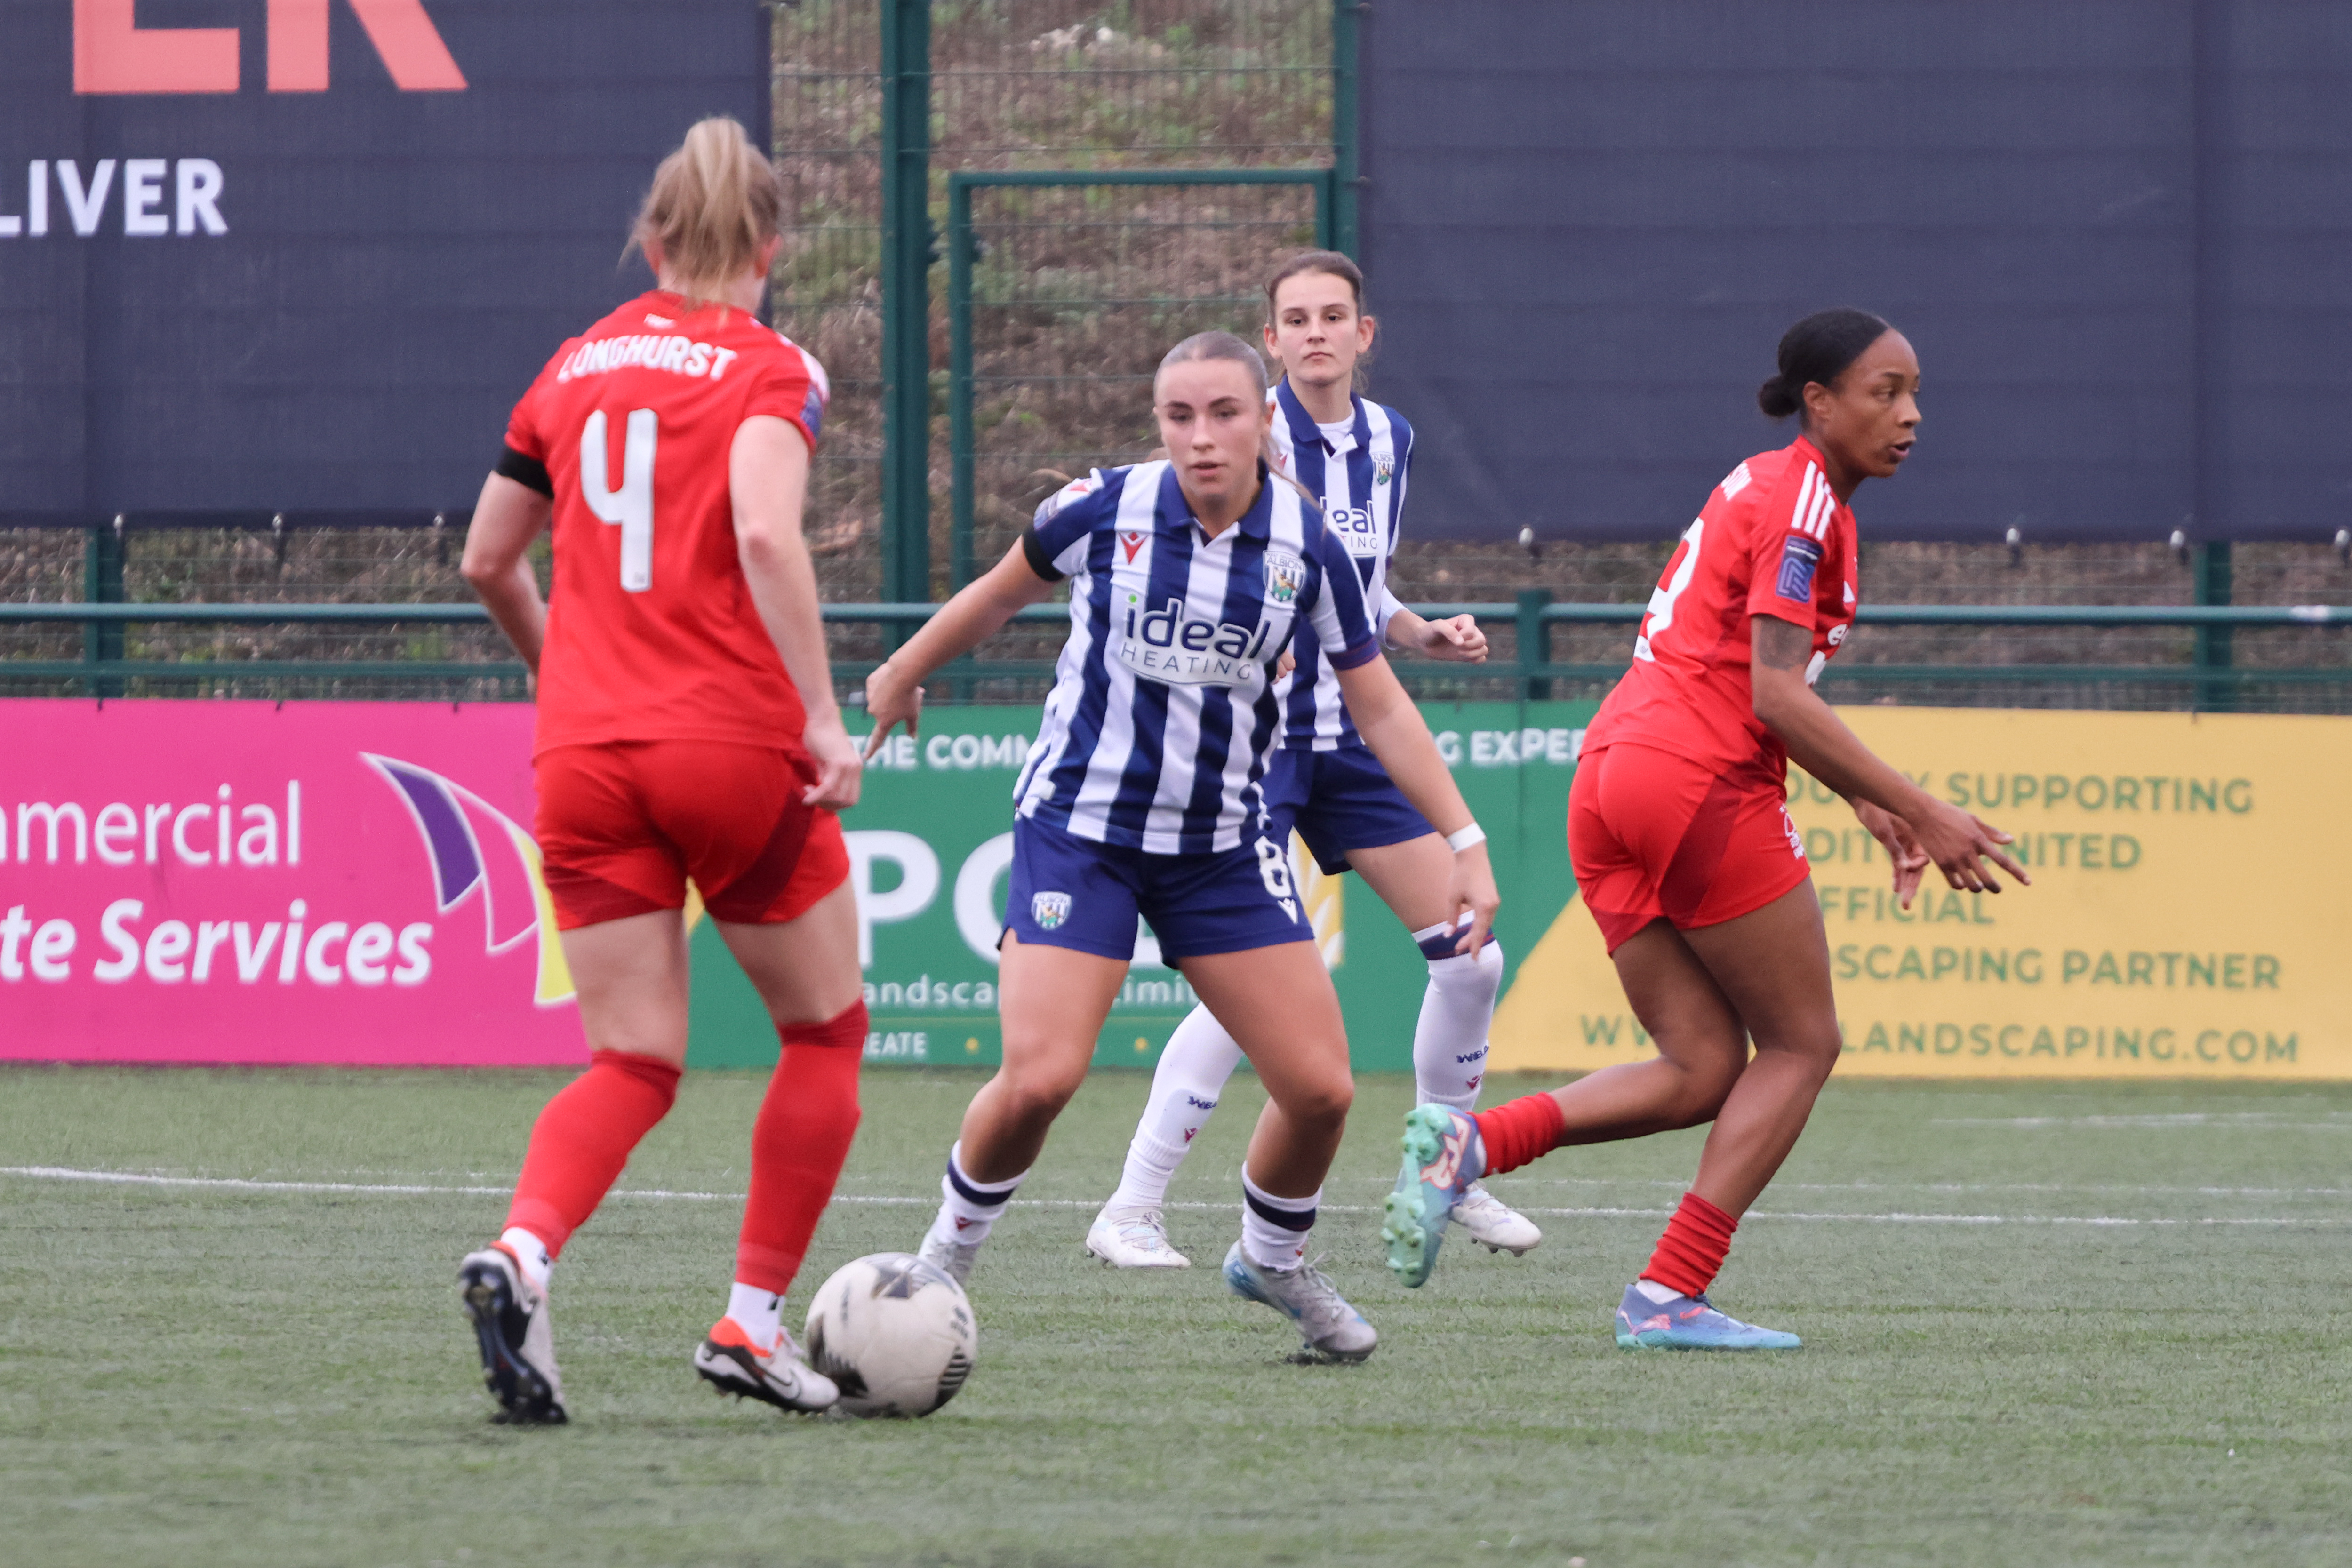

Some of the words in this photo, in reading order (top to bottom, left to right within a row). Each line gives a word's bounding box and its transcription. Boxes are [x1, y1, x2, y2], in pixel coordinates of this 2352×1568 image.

[556, 335, 738, 381] LONGHURST
[580, 408, 659, 593] 4
[1267, 556, 1303, 571] ALBION
[1125, 593, 1272, 659] ideal
[1121, 642, 1251, 680] HEATING
[1947, 773, 2254, 814] SUPPORTING
[0, 780, 300, 865] mercial
[1254, 835, 1292, 898] 8
[1979, 831, 2143, 869] NITED
[0, 904, 77, 983] te
[93, 898, 433, 985] Services
[2063, 950, 2282, 989] PARTNER
[1456, 1045, 1489, 1063] WBA
